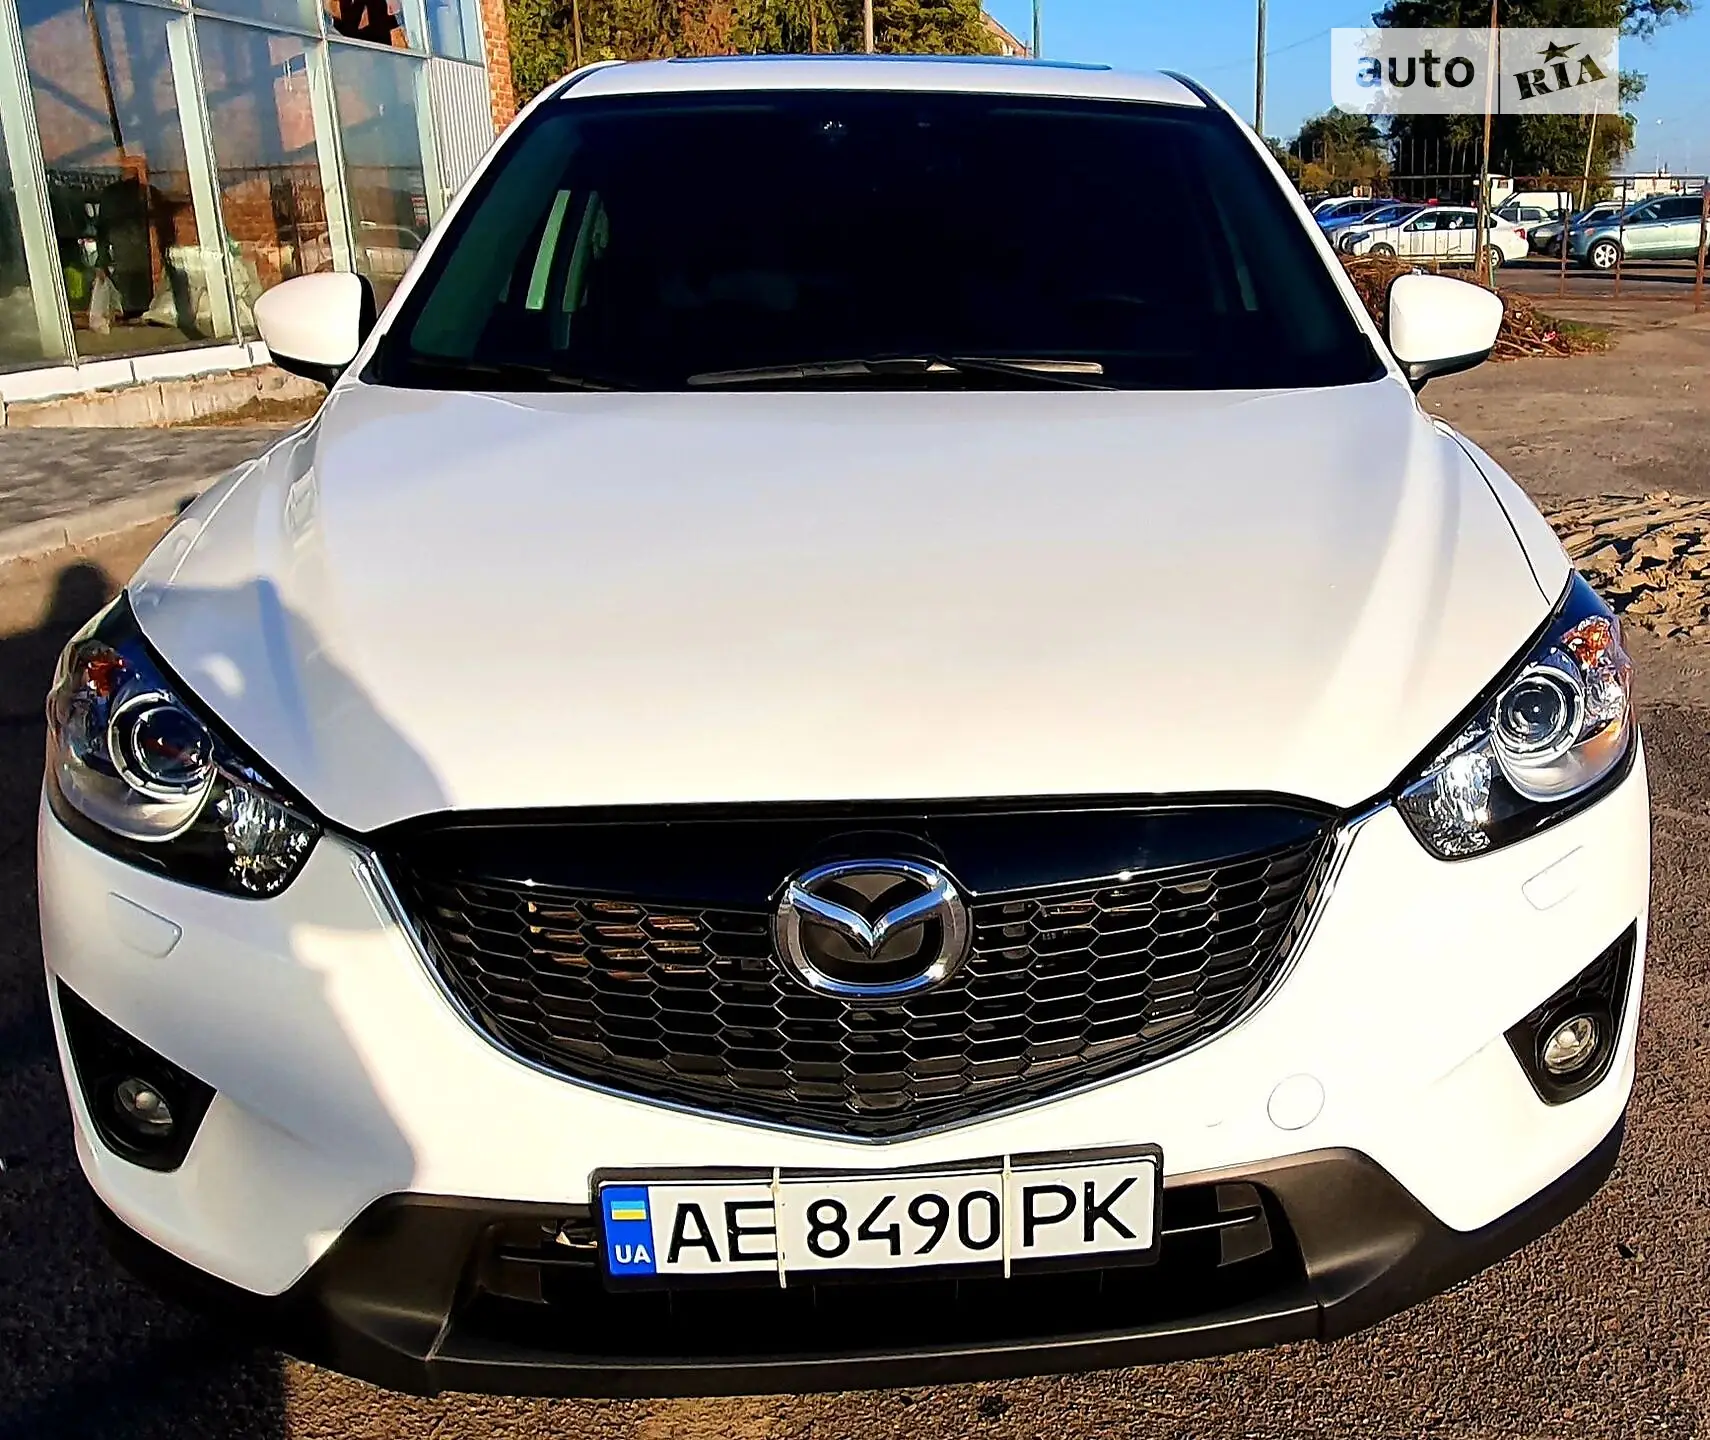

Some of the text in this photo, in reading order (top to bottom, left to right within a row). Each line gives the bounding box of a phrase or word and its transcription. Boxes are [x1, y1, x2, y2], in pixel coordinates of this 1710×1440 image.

[667, 1177, 1138, 1264] AE 8490 PK
[614, 1244, 651, 1265] UA
